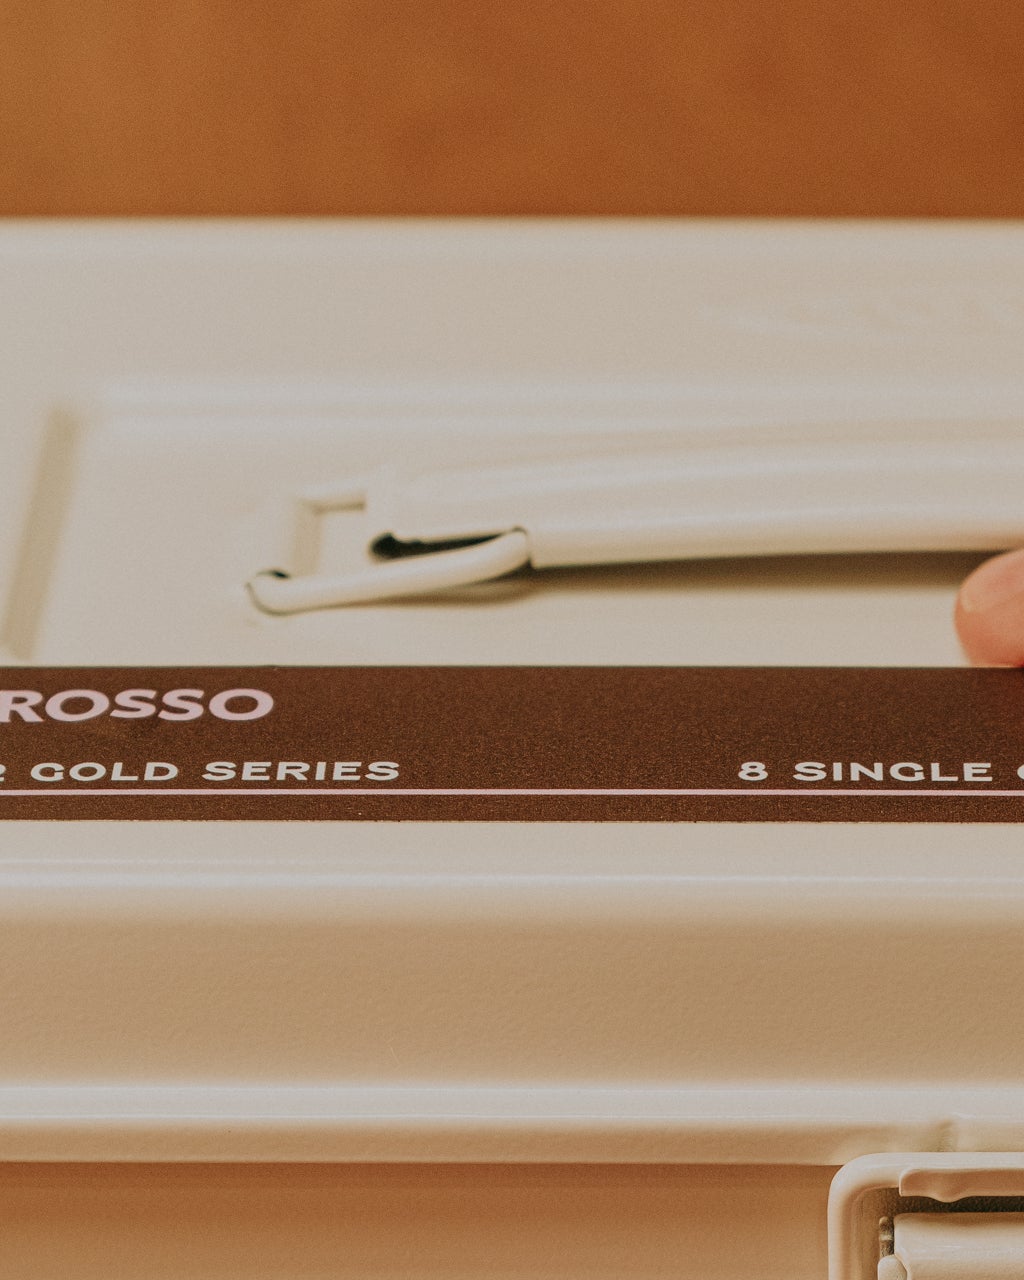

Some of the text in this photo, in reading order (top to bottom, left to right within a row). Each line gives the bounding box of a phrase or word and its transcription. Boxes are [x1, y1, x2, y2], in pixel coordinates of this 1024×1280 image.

[0, 688, 274, 723] ROSSO
[30, 761, 179, 783] GOLD
[201, 760, 401, 783] SERIES
[737, 761, 769, 783] 8
[792, 761, 994, 784] SINGLE
